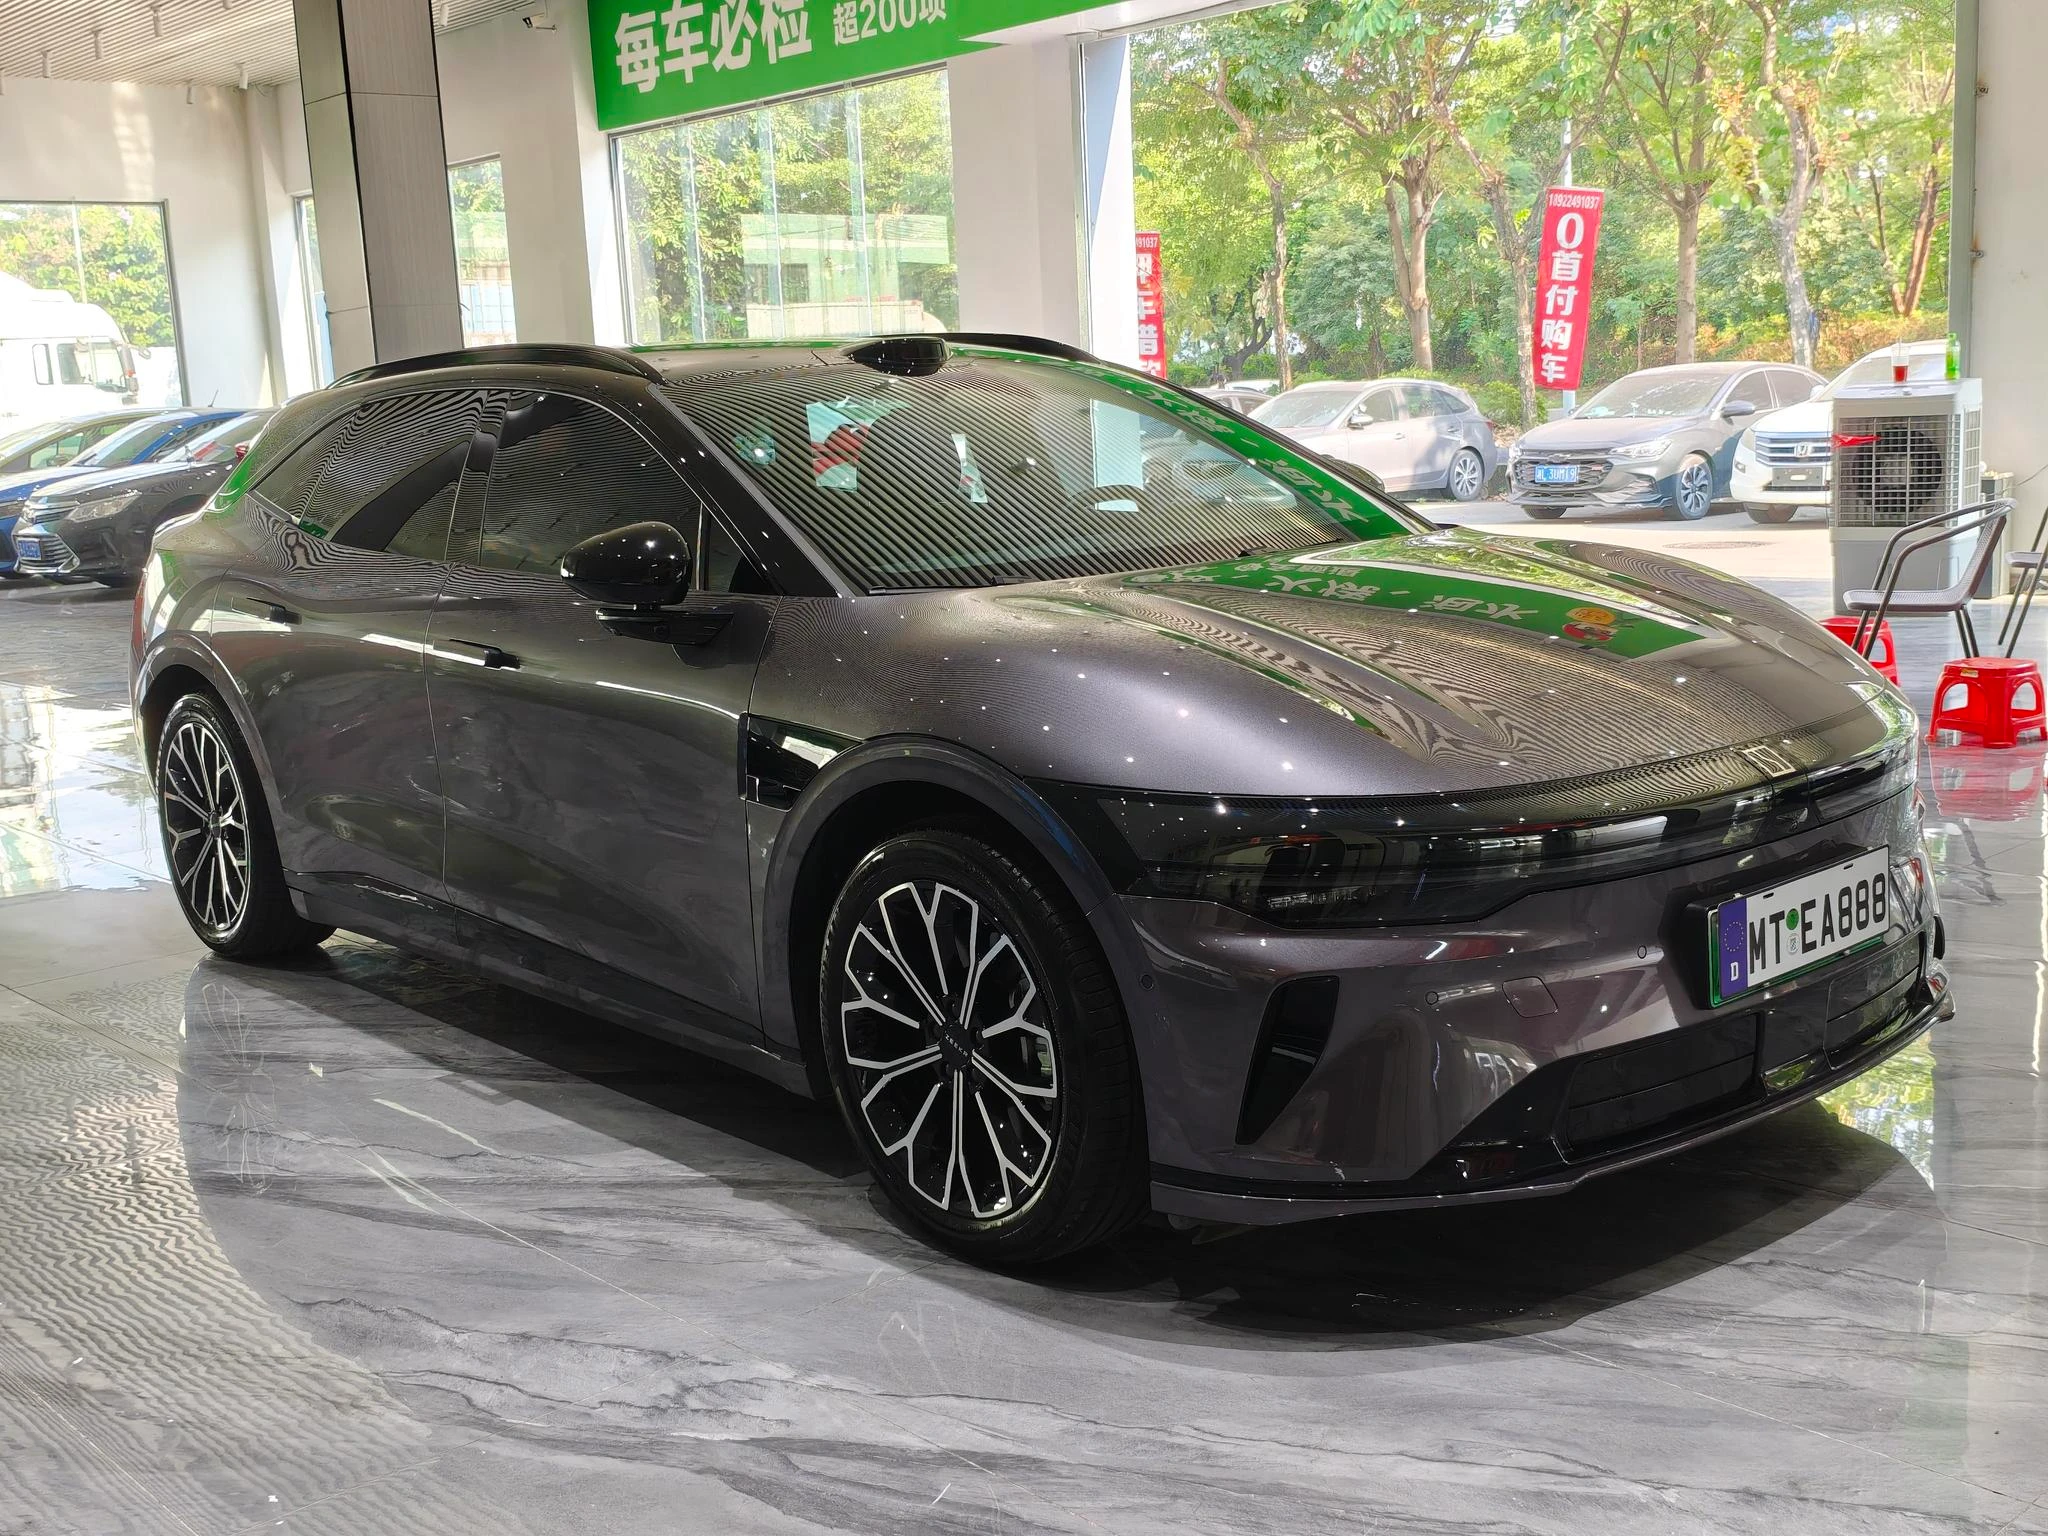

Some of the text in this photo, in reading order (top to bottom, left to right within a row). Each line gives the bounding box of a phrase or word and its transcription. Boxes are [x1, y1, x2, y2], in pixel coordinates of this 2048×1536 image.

[615, 0, 812, 93] 每车必检
[833, 0, 946, 46] 超200项
[1549, 193, 1600, 210] 18922491037
[1541, 213, 1584, 382] 0首付购车
[1750, 873, 1886, 975] MT EA888
[1730, 961, 1739, 982] D
